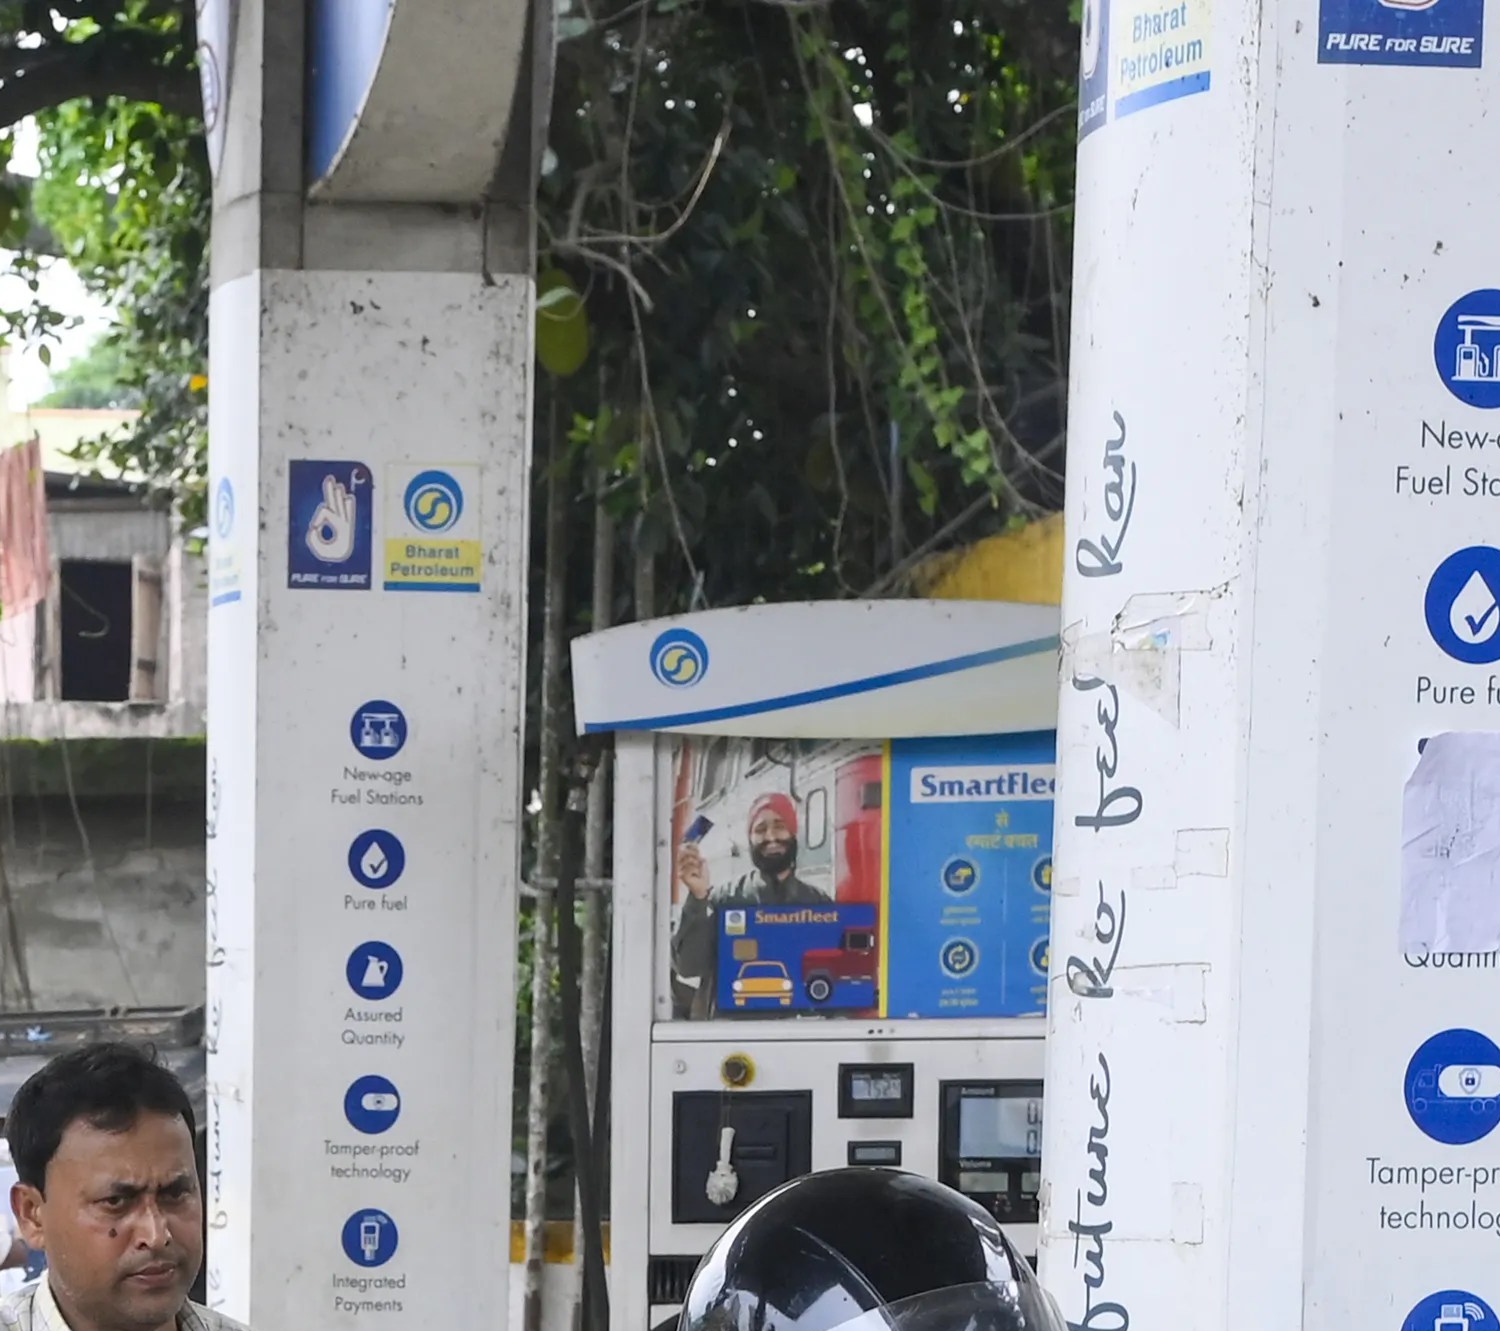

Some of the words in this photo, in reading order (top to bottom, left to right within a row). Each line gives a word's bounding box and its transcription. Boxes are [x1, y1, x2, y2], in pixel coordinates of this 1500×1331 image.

[1133, 1, 1186, 43] Bharat
[1326, 33, 1381, 51] PURE
[1385, 38, 1417, 53] FOR
[1419, 36, 1475, 55] SURE
[1120, 39, 1203, 84] Petroleum
[1395, 465, 1451, 498] Fuel
[1075, 408, 1137, 578] kar
[405, 544, 460, 560] Bharat
[390, 561, 475, 578] Petroleum
[1416, 676, 1476, 706] Pure
[343, 766, 412, 785] New-age
[330, 789, 362, 806] Fuel
[366, 789, 424, 808] Stations
[343, 895, 375, 912] Pure
[380, 894, 408, 912] fuel
[343, 1007, 403, 1024] Assured
[340, 1029, 406, 1049] Quantity
[322, 1139, 420, 1160] Tamper-proof
[330, 1162, 411, 1184] technology
[331, 1273, 407, 1294] Integrated
[334, 1297, 404, 1316] Payments
